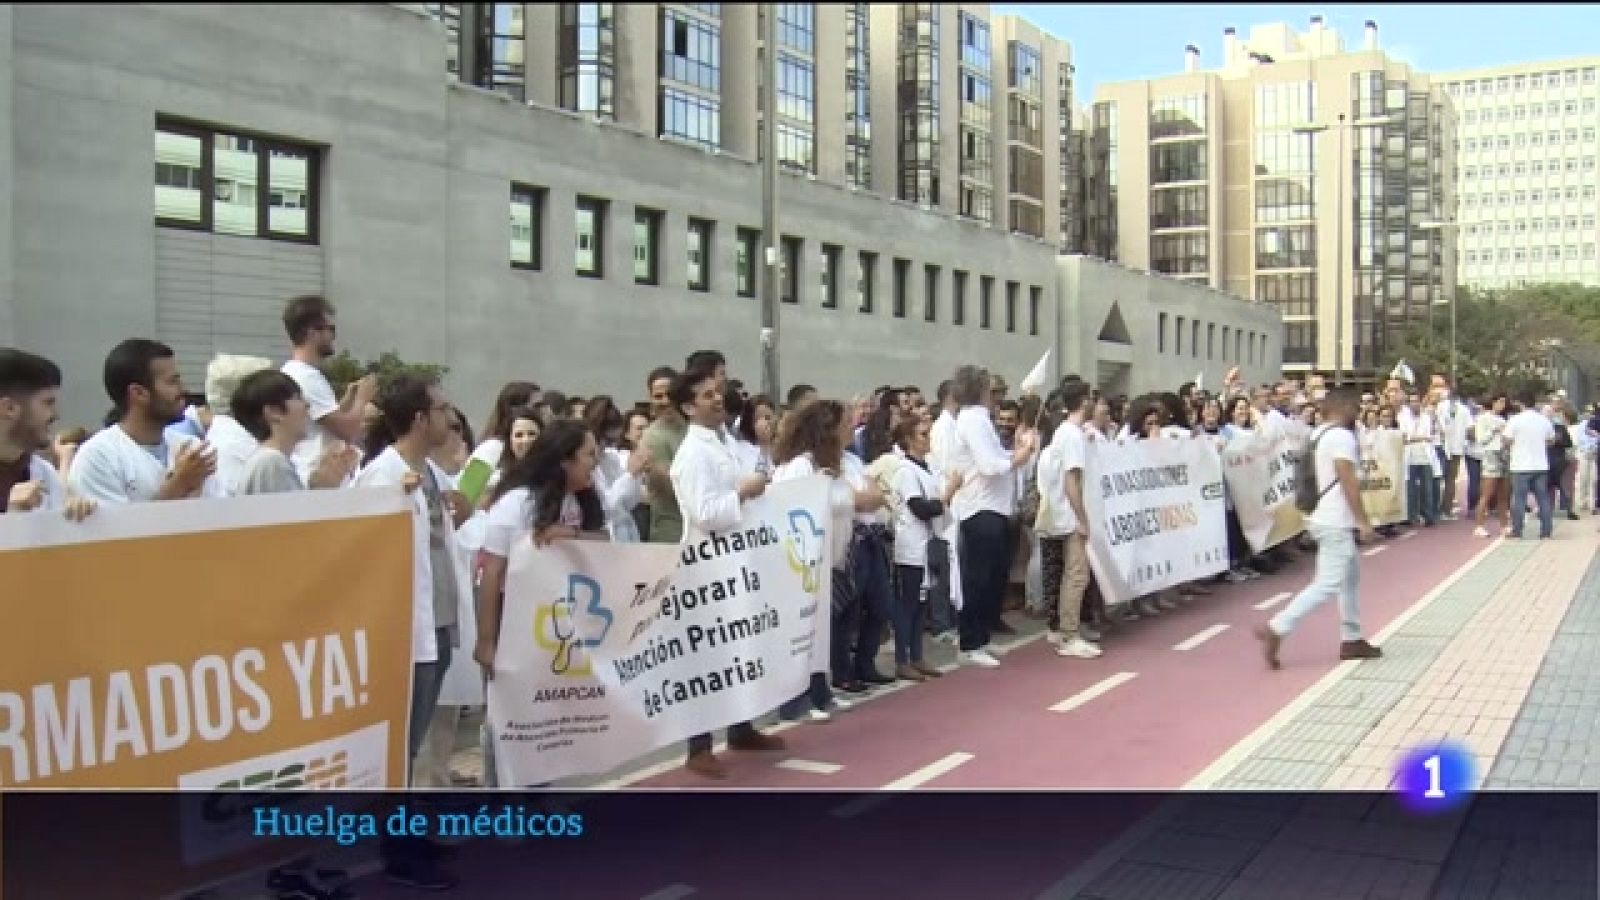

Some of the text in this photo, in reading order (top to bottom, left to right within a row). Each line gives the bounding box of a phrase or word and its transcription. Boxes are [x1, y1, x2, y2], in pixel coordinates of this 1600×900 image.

[676, 520, 779, 568] uchando
[656, 576, 736, 621] ejorar
[739, 565, 761, 593] la
[686, 602, 780, 653] Primaria
[282, 627, 369, 720] YA!
[662, 656, 765, 706] Canarias
